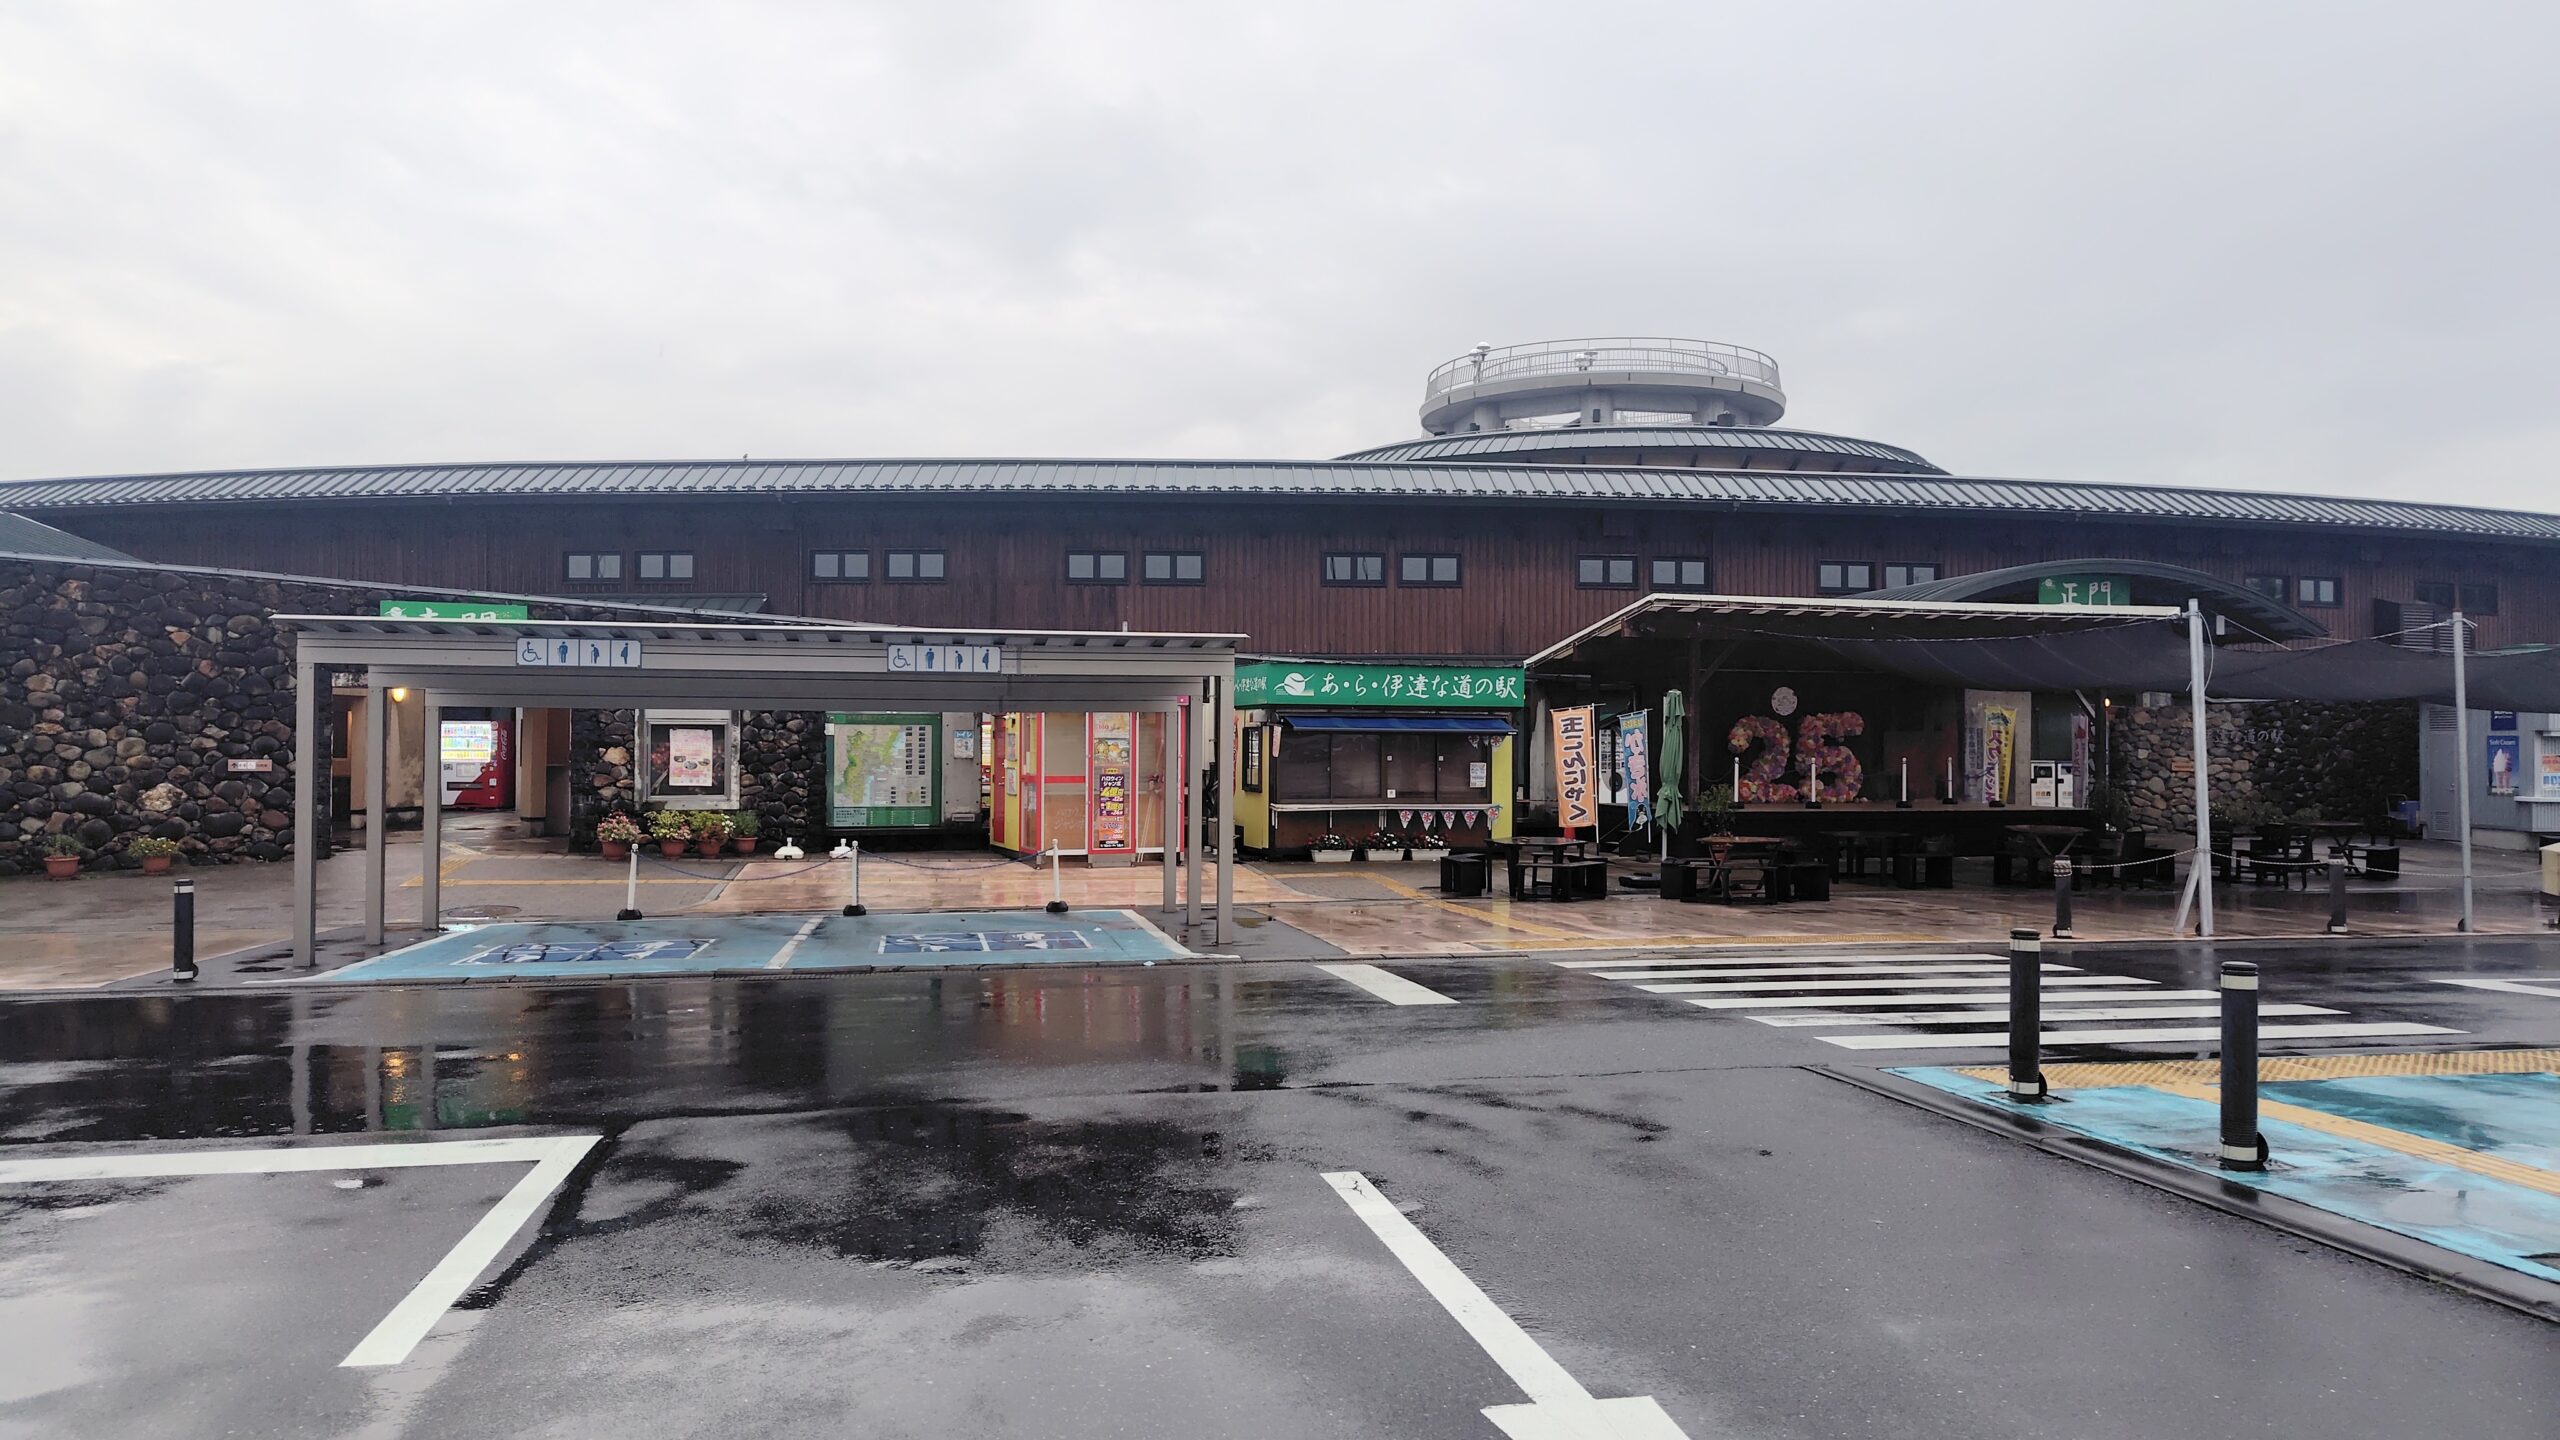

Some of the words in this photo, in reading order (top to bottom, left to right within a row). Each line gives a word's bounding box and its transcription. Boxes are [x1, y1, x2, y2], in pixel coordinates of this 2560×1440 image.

[2061, 581, 2111, 605] 正門
[1321, 673, 1518, 699] あ・ら・伊達な道の駅
[1560, 716, 1587, 821] 玉こんにゃく
